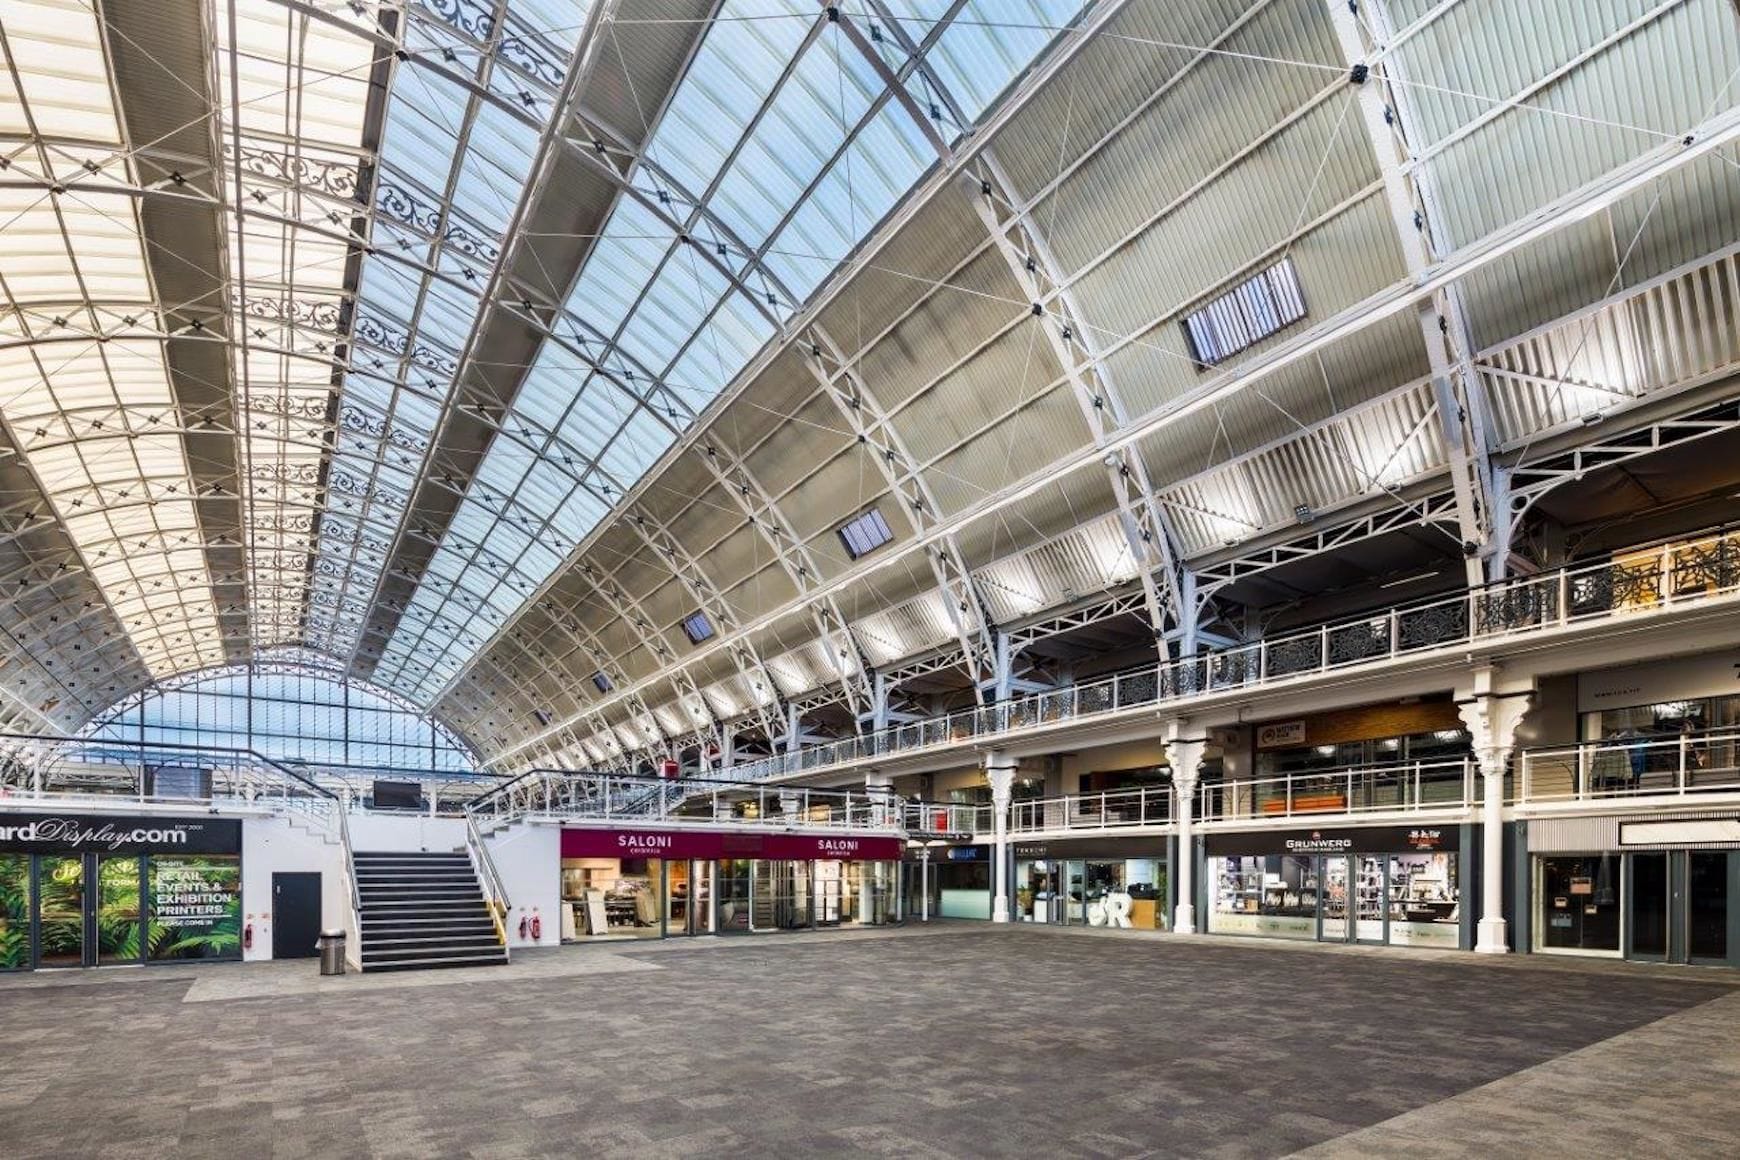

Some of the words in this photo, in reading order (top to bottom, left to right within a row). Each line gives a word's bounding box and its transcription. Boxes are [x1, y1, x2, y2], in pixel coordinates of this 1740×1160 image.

[618, 835, 672, 848] SALONI
[817, 839, 860, 851] SALONI
[1285, 839, 1352, 849] GRUNWERG
[156, 882, 210, 892] EVENTS
[211, 881, 223, 891] &
[156, 893, 232, 905] EXHIBITION
[156, 904, 224, 916] PRINTERS
